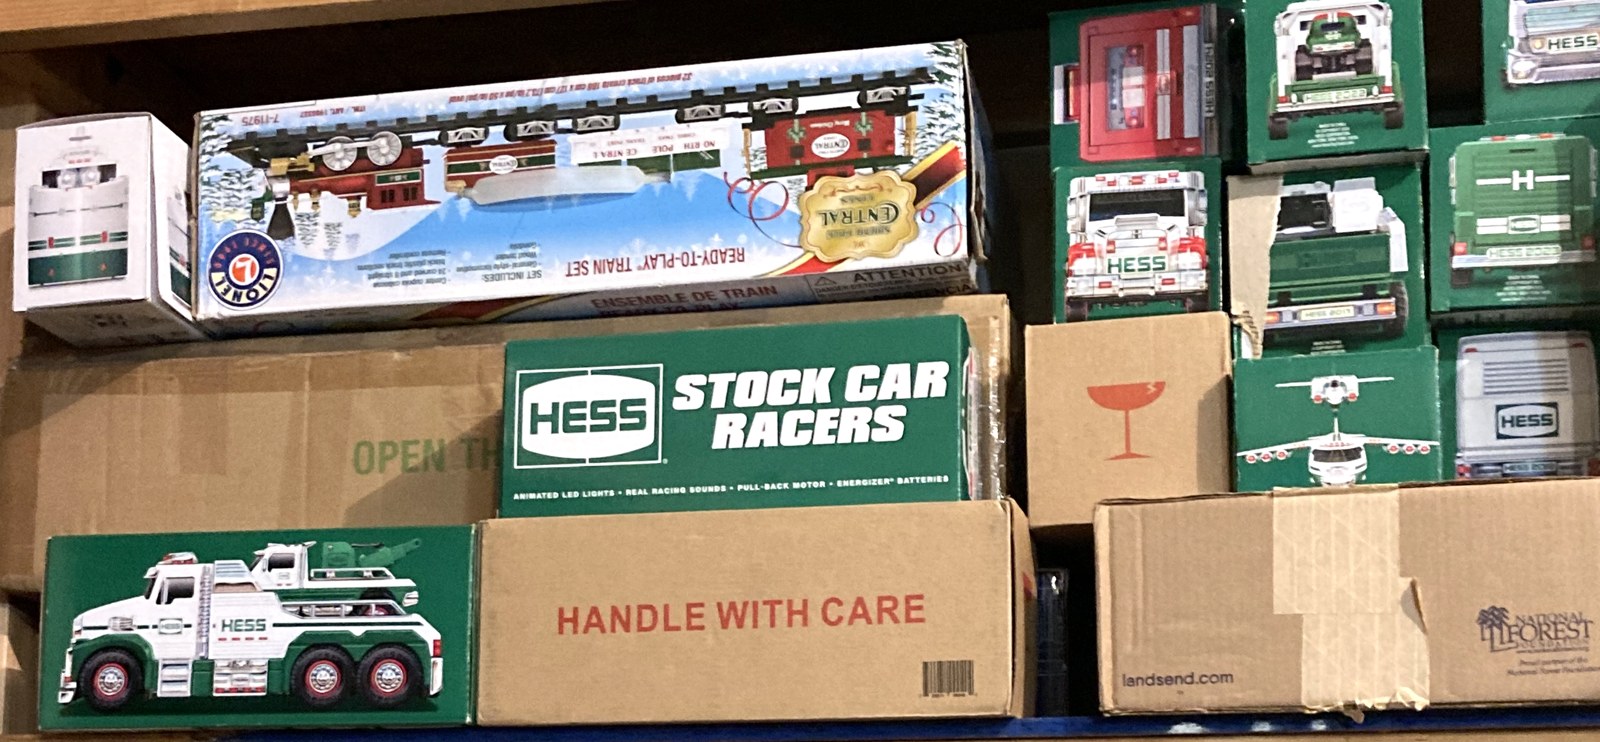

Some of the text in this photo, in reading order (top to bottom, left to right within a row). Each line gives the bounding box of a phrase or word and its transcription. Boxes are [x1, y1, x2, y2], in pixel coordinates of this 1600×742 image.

[1548, 35, 1598, 50] HESS
[242, 114, 280, 127] 7-11975
[652, 144, 675, 154] POLE
[1512, 169, 1534, 191] H
[818, 203, 900, 226] CENTRAL
[235, 258, 252, 283] L
[565, 261, 590, 278] SET
[593, 257, 632, 275] TRAIN
[1107, 255, 1167, 274] HESS
[481, 269, 542, 283] SET INCLUDES:
[215, 274, 275, 302] LIONEL
[590, 284, 779, 309] ENSEMBLE DE TRAIN
[672, 360, 950, 411] STOCK CAR
[530, 398, 647, 435] HESS
[711, 404, 908, 450] RACERS
[1501, 413, 1554, 428] HESS
[353, 438, 446, 475] OPEN
[513, 492, 559, 500] ANIMATED
[562, 491, 579, 499] LED
[582, 489, 615, 498] LIGHTS
[626, 488, 648, 496] REAL
[652, 486, 687, 495] RACING
[689, 485, 726, 493] SOUNDS
[737, 482, 790, 491] PULL-BACK
[792, 481, 826, 489] MOTOR
[897, 475, 949, 485] BATTERIES
[221, 618, 267, 632] HESS
[557, 594, 927, 635] HANDLE WITH CARE
[1515, 612, 1584, 625] NATIONAL
[1507, 620, 1594, 643] FOREST
[1122, 672, 1234, 687] landsend.com
